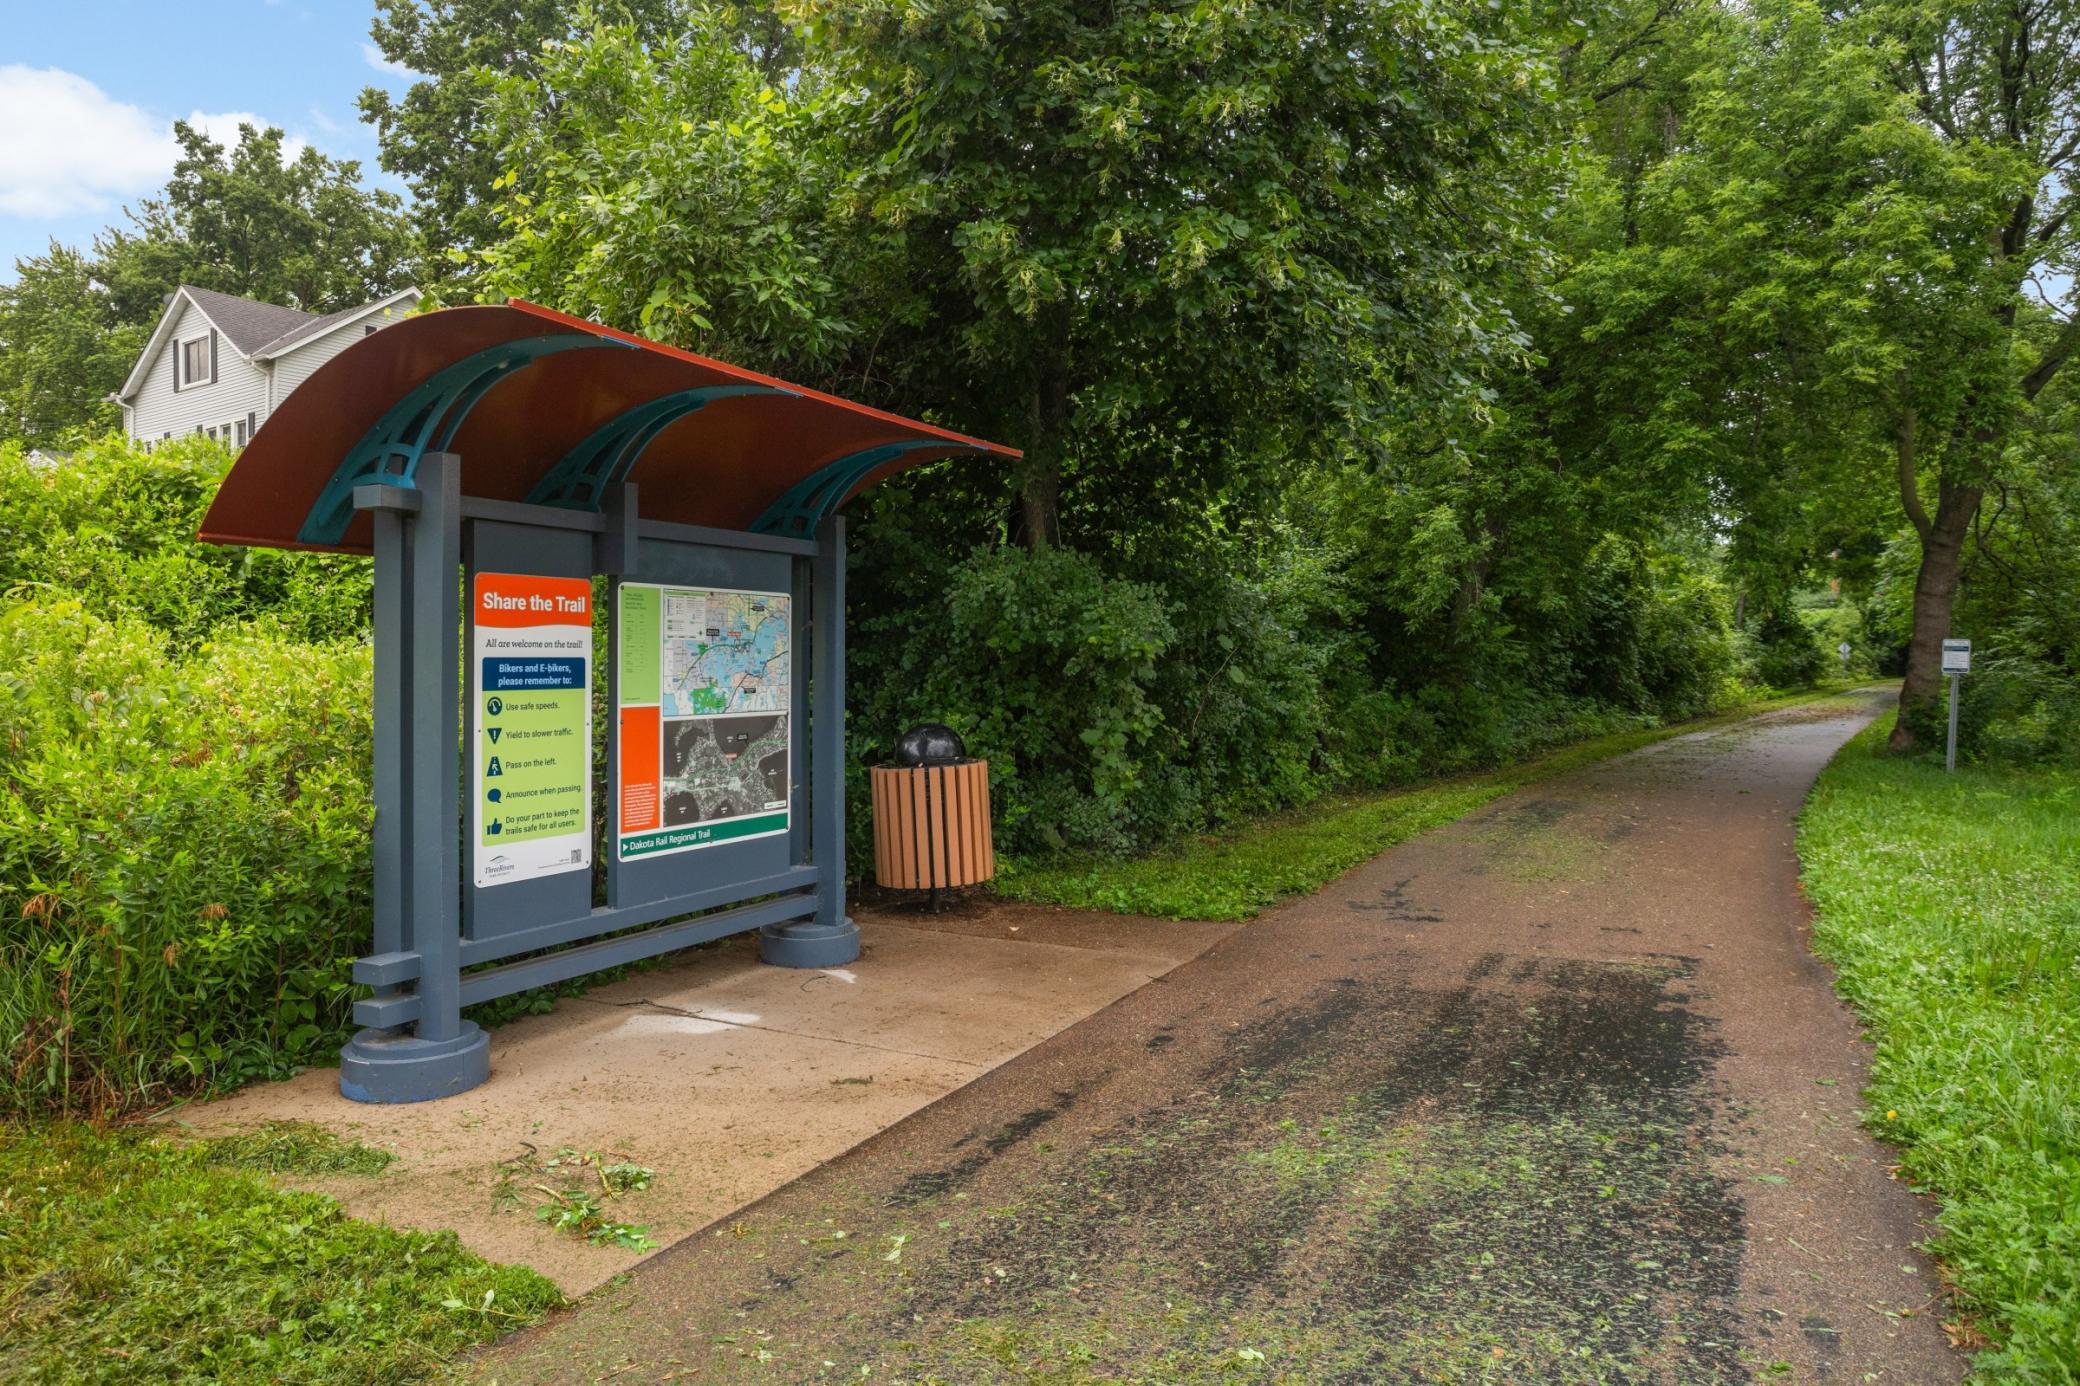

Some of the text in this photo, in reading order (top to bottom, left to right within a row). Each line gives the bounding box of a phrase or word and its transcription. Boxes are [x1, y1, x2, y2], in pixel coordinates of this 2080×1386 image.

[483, 592, 585, 613] Share the Trail
[485, 639, 496, 648] All
[511, 640, 542, 648] welcome
[554, 640, 565, 648] the
[566, 640, 583, 648] trail!
[499, 663, 571, 673] Bikers and E-bikers,
[498, 676, 572, 687] please remember to:
[505, 701, 560, 711] Use safe speeds.
[505, 730, 522, 739] Yield
[532, 729, 552, 737] slower
[553, 727, 573, 736] traffic.
[505, 761, 522, 769] Pass
[533, 758, 544, 767] the
[505, 789, 538, 799] Announce
[539, 787, 556, 795] when
[505, 807, 580, 824] Do your part to keep the
[505, 819, 576, 835] trails safe for all users.
[630, 829, 711, 851] Dakota Rail Regional Trail
